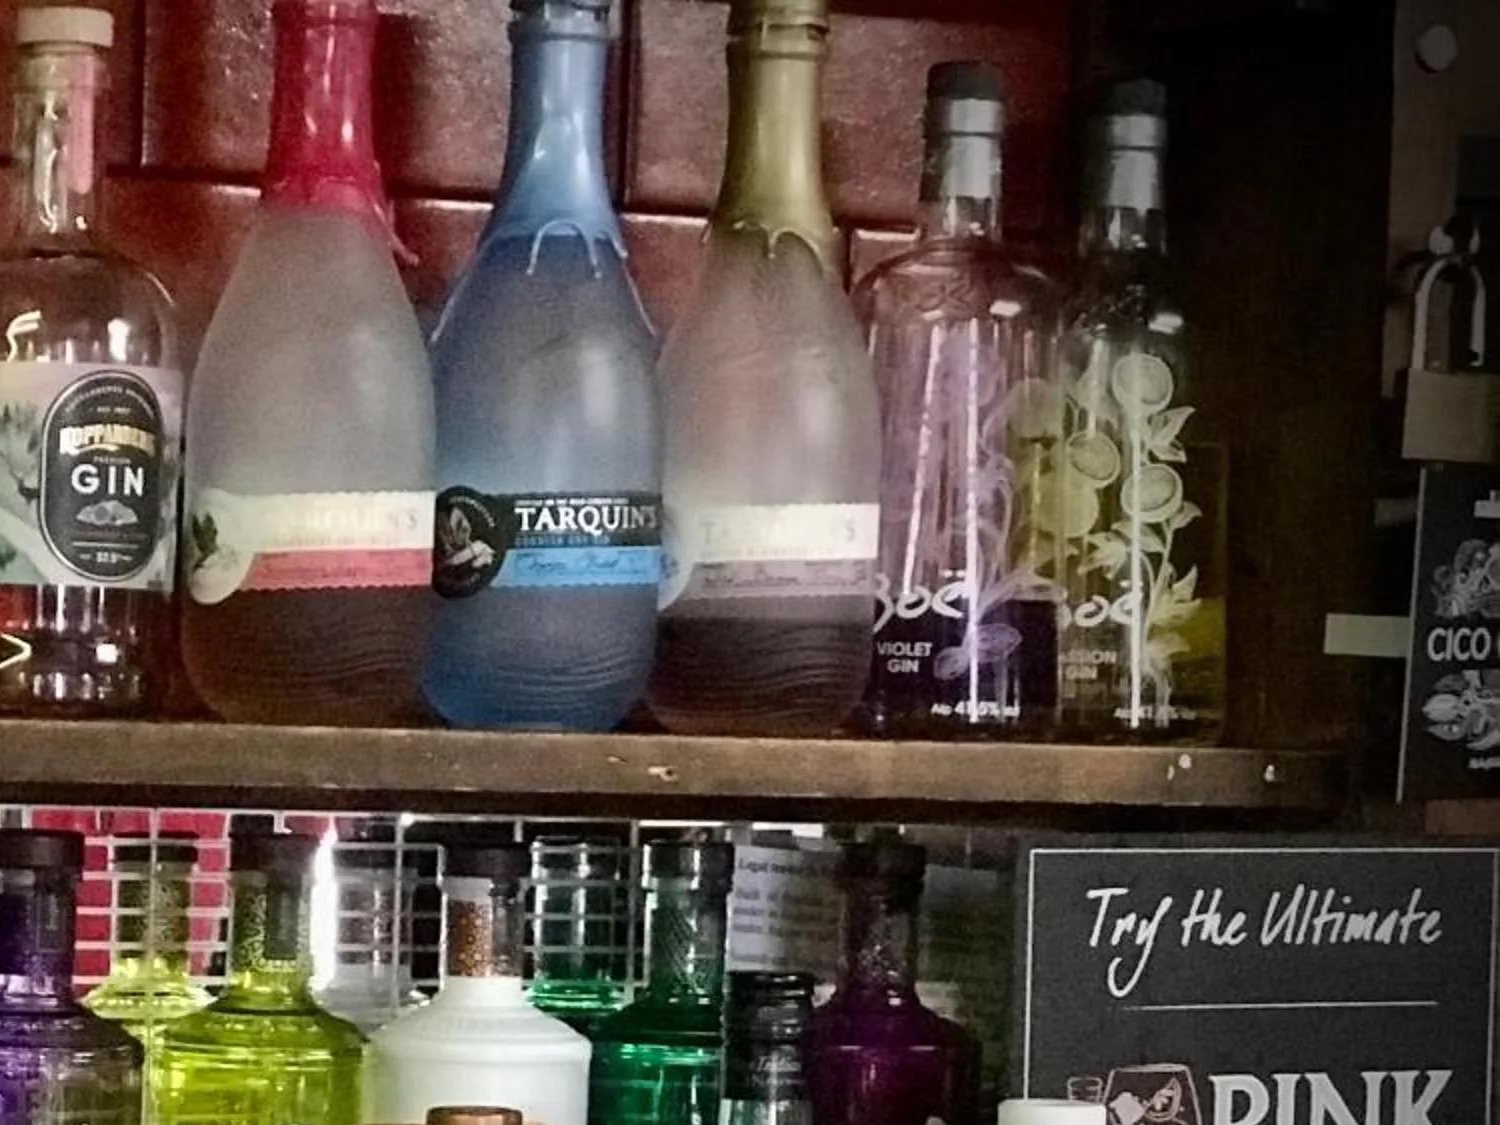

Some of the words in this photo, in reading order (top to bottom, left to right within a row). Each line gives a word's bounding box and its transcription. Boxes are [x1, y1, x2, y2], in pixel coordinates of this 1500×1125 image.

[70, 463, 145, 498] GIN
[876, 640, 933, 658] VIOLET
[1427, 626, 1492, 663] CICO
[886, 658, 919, 675] GIN
[1086, 886, 1173, 999] Try
[1181, 887, 1248, 948] the
[1260, 884, 1443, 947] Ultimate
